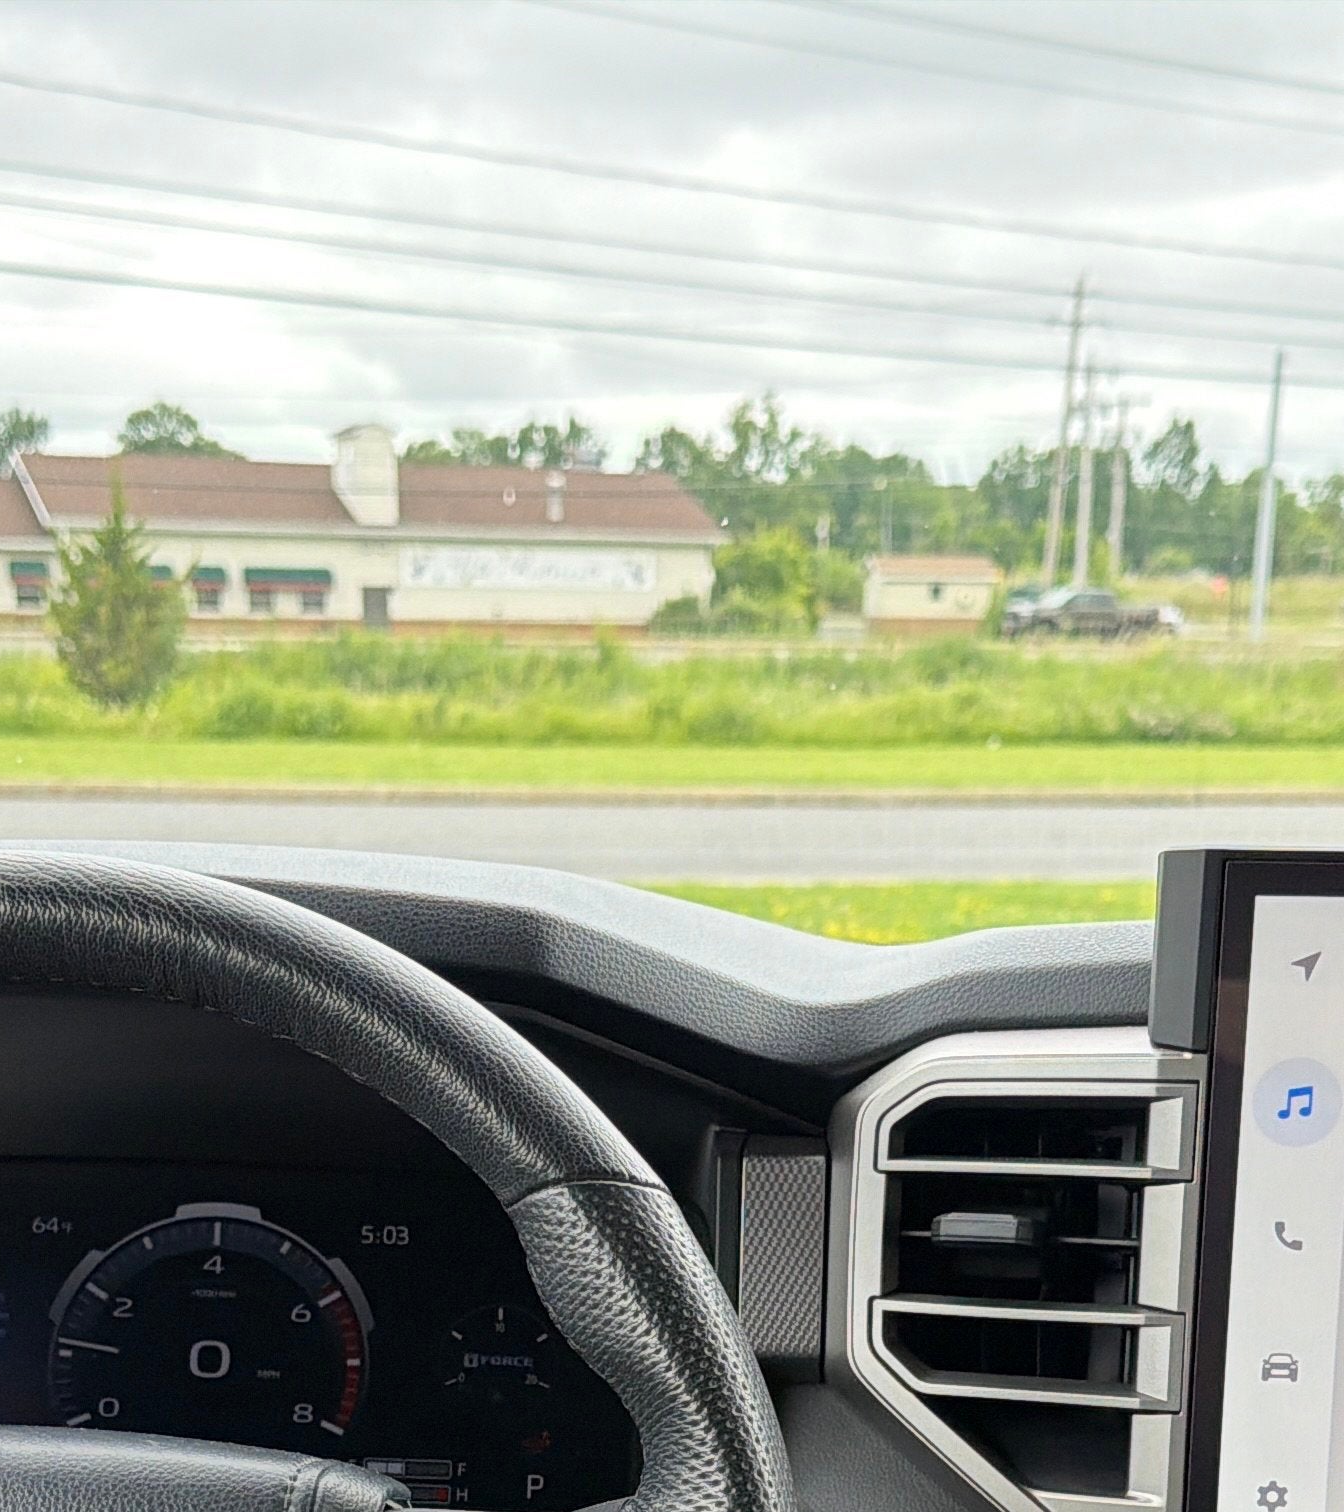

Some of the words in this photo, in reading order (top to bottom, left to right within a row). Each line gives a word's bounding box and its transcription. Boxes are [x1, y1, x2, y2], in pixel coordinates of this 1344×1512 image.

[360, 1226, 410, 1246] 5:03
[202, 1255, 225, 1275] 4
[112, 1297, 134, 1318] 2
[290, 1303, 312, 1323] 6
[189, 1339, 231, 1378] 0
[98, 1397, 120, 1417] 0
[292, 1403, 314, 1423] 8
[457, 1462, 467, 1476] F
[456, 1488, 468, 1502] H
[526, 1474, 545, 1500] P
